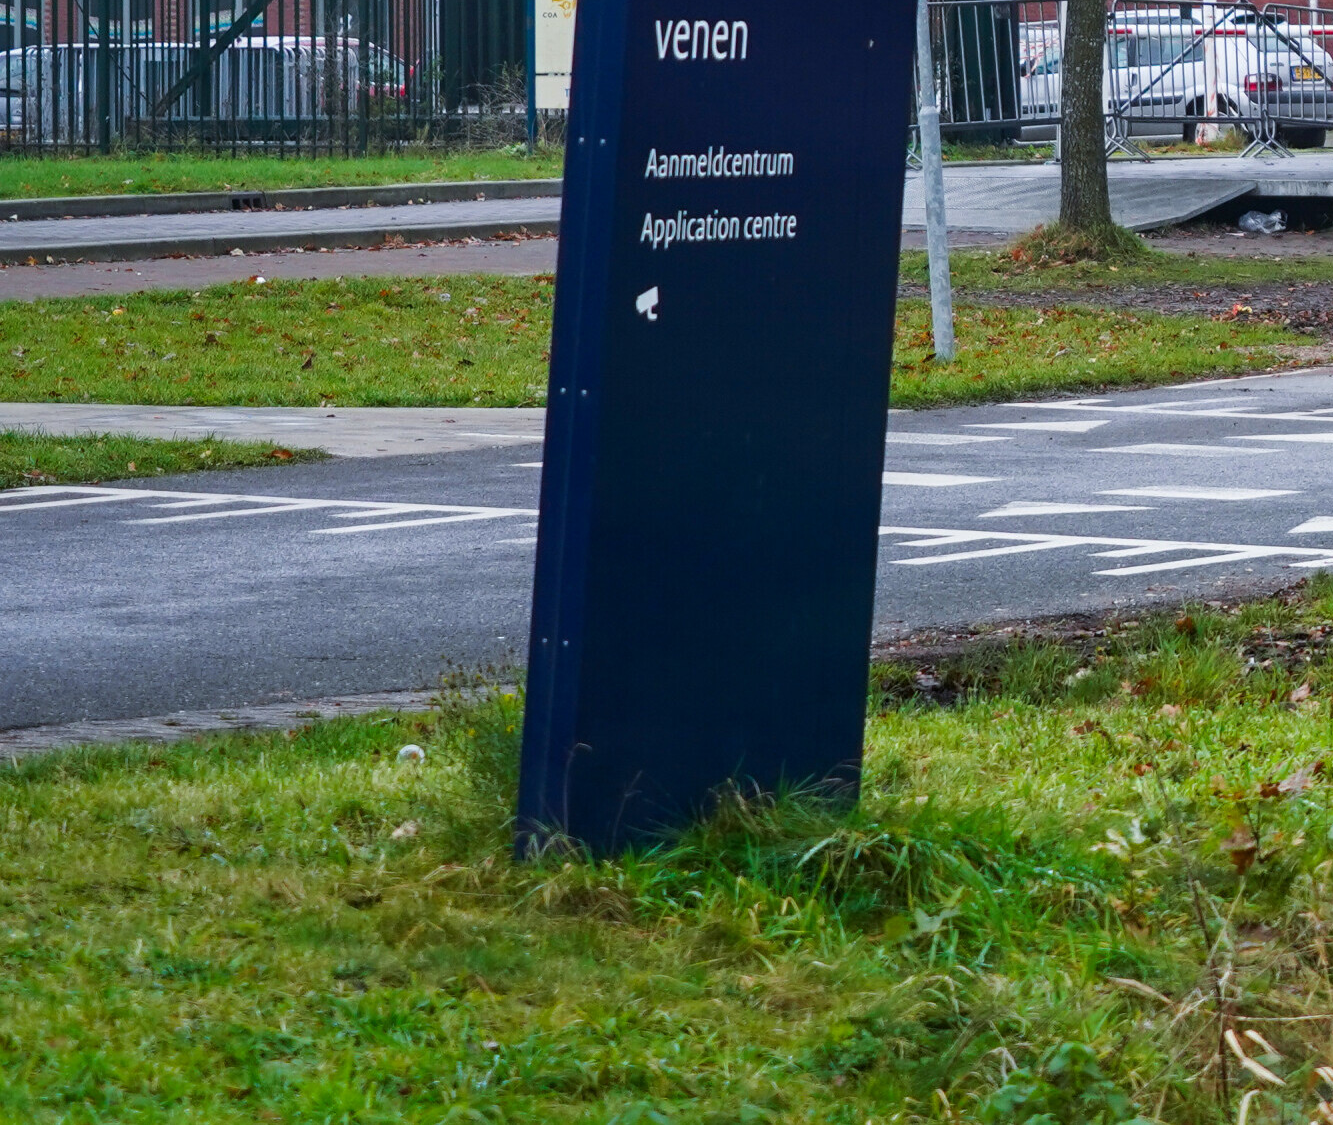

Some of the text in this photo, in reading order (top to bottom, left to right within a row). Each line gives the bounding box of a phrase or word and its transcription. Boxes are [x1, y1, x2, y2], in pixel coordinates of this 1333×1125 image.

[655, 19, 748, 60] venen
[644, 146, 795, 178] Aanmeldcentrum
[640, 209, 797, 250] Application centre
